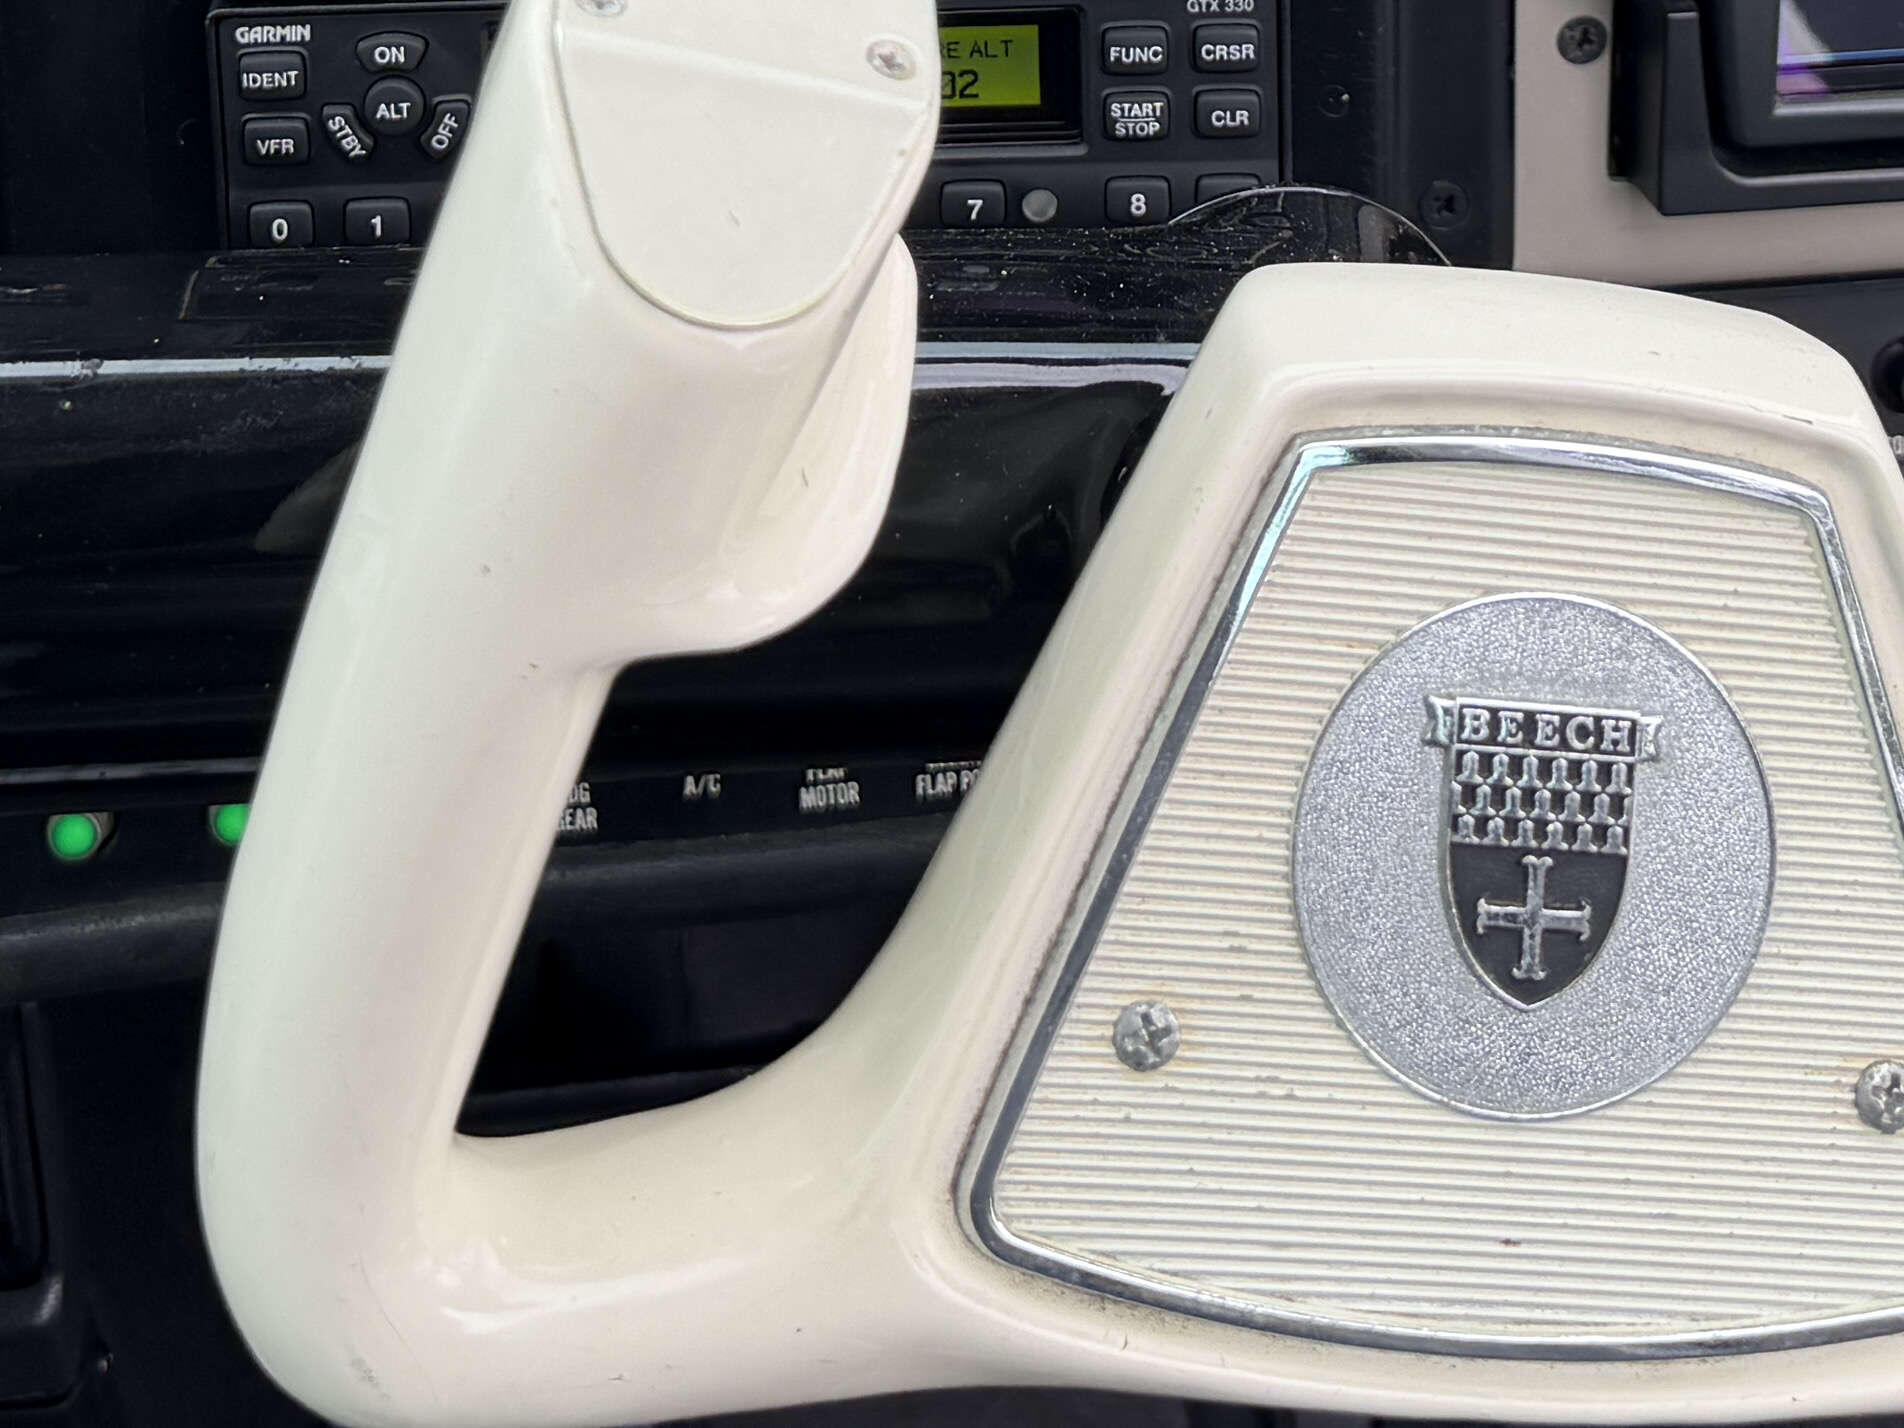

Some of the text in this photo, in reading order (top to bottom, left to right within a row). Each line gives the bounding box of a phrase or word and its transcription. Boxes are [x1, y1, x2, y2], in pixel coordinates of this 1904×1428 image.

[1109, 46, 1163, 62] FUNC
[242, 71, 299, 88] IDENT
[1211, 110, 1249, 127] CLR
[1460, 708, 1633, 753] BEECH
